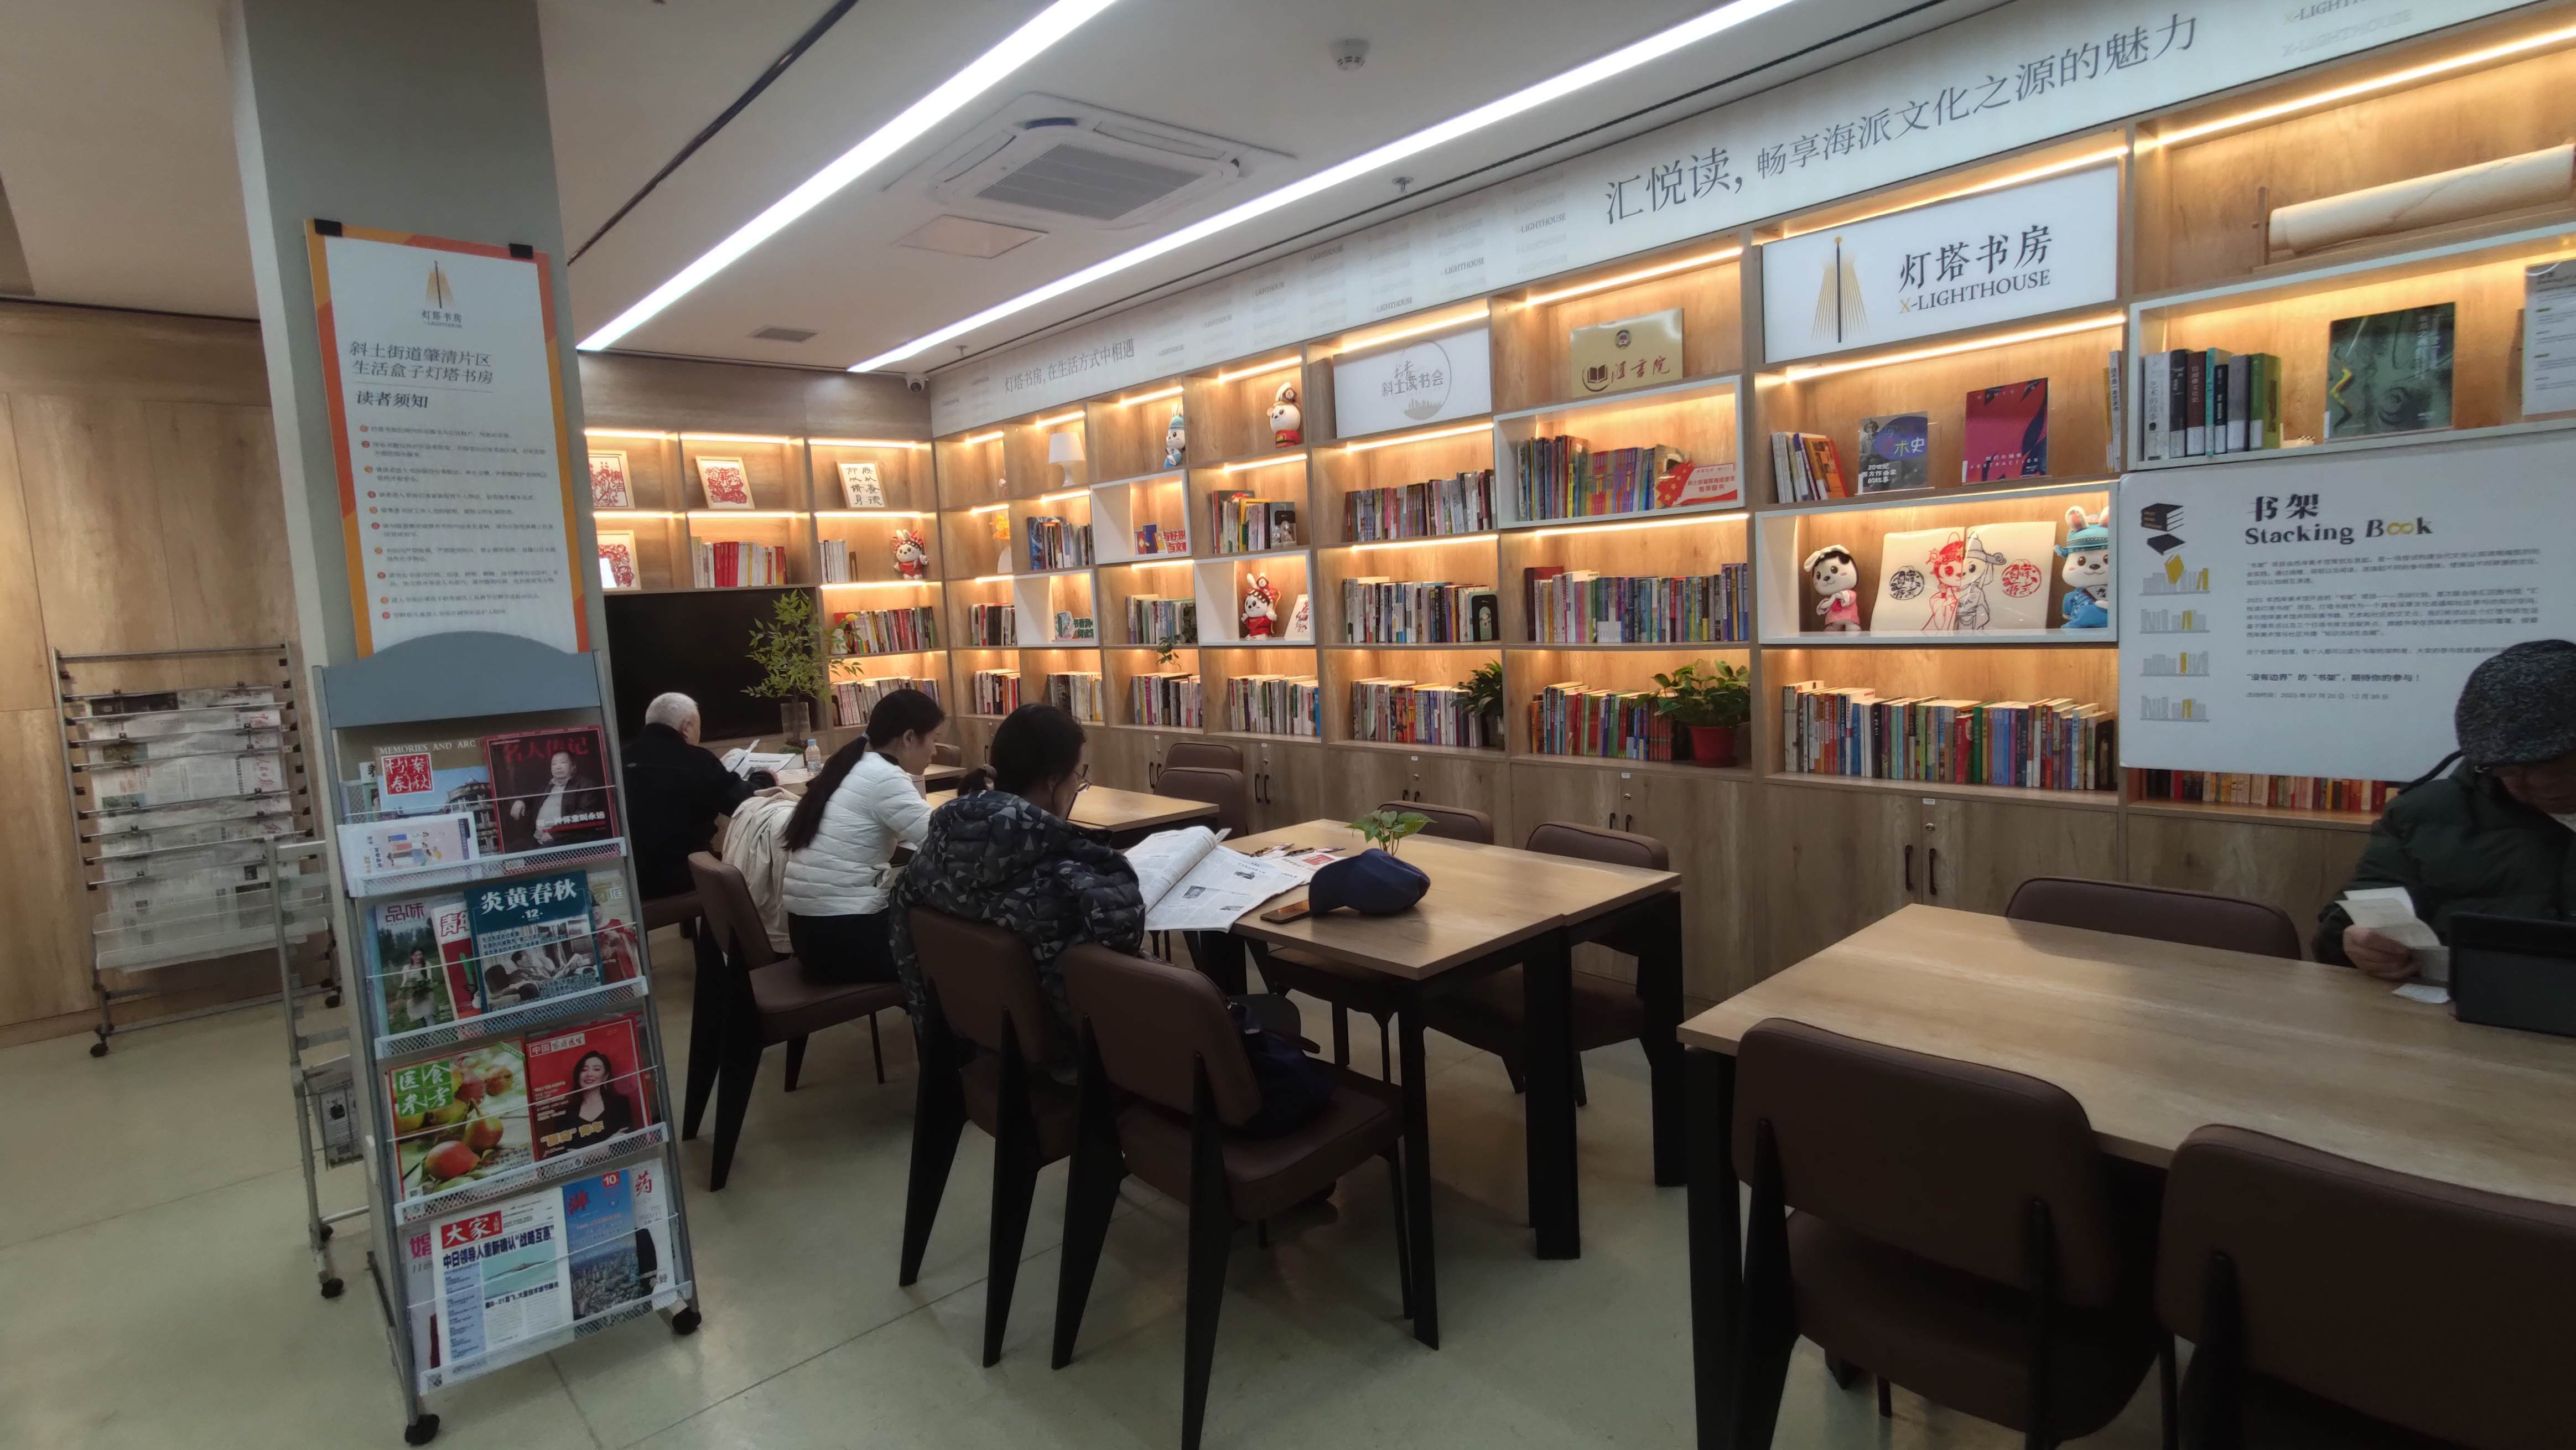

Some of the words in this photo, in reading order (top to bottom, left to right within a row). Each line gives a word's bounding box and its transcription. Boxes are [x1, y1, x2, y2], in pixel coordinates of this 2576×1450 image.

[1899, 224, 2052, 293] 灯塔书房
[1899, 269, 2051, 314] X-LIGHTHOUSE
[422, 309, 462, 325] 灯塔书房
[349, 340, 492, 367] 斜土街道肇清片区
[353, 360, 494, 385] 生活盒子灯塔书房
[1381, 369, 1443, 397] 斜土读书会
[357, 390, 428, 409] 读者须知
[2246, 493, 2320, 522] 书架
[2245, 522, 2355, 545] Stacking
[380, 743, 429, 754] MEMORIES
[433, 742, 453, 751] AND
[391, 775, 432, 793] 春秋
[480, 877, 577, 915] 炎黄春秋
[385, 903, 425, 923] 品味
[603, 1174, 617, 1185] 10
[635, 1169, 653, 1197] 药
[444, 1217, 492, 1247] 大家
